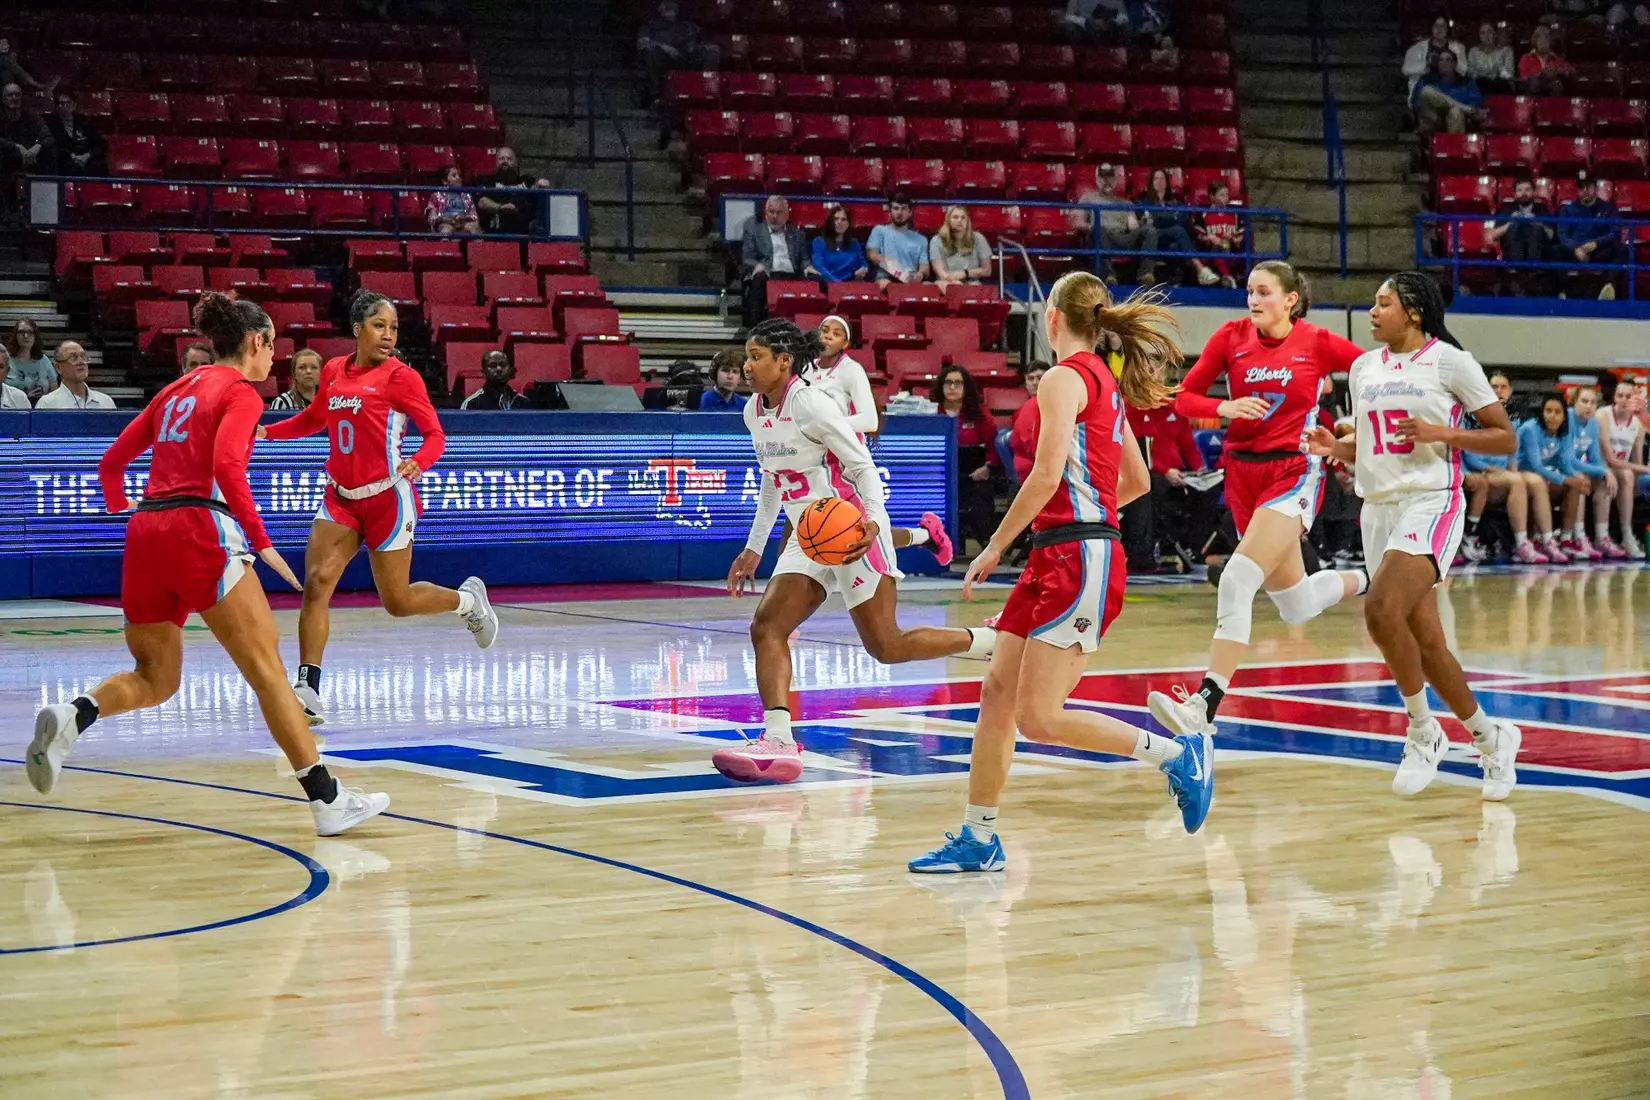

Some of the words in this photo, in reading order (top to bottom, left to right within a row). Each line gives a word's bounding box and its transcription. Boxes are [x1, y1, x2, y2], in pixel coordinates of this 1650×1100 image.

[1244, 366, 1293, 387] Liberty
[157, 395, 196, 443] 12
[328, 395, 362, 415] Liberty
[1252, 391, 1286, 422] 7
[338, 419, 354, 455] 0
[1367, 409, 1415, 455] 15
[30, 475, 100, 513] THE
[422, 470, 568, 510] PARTNER
[574, 468, 614, 508] OF
